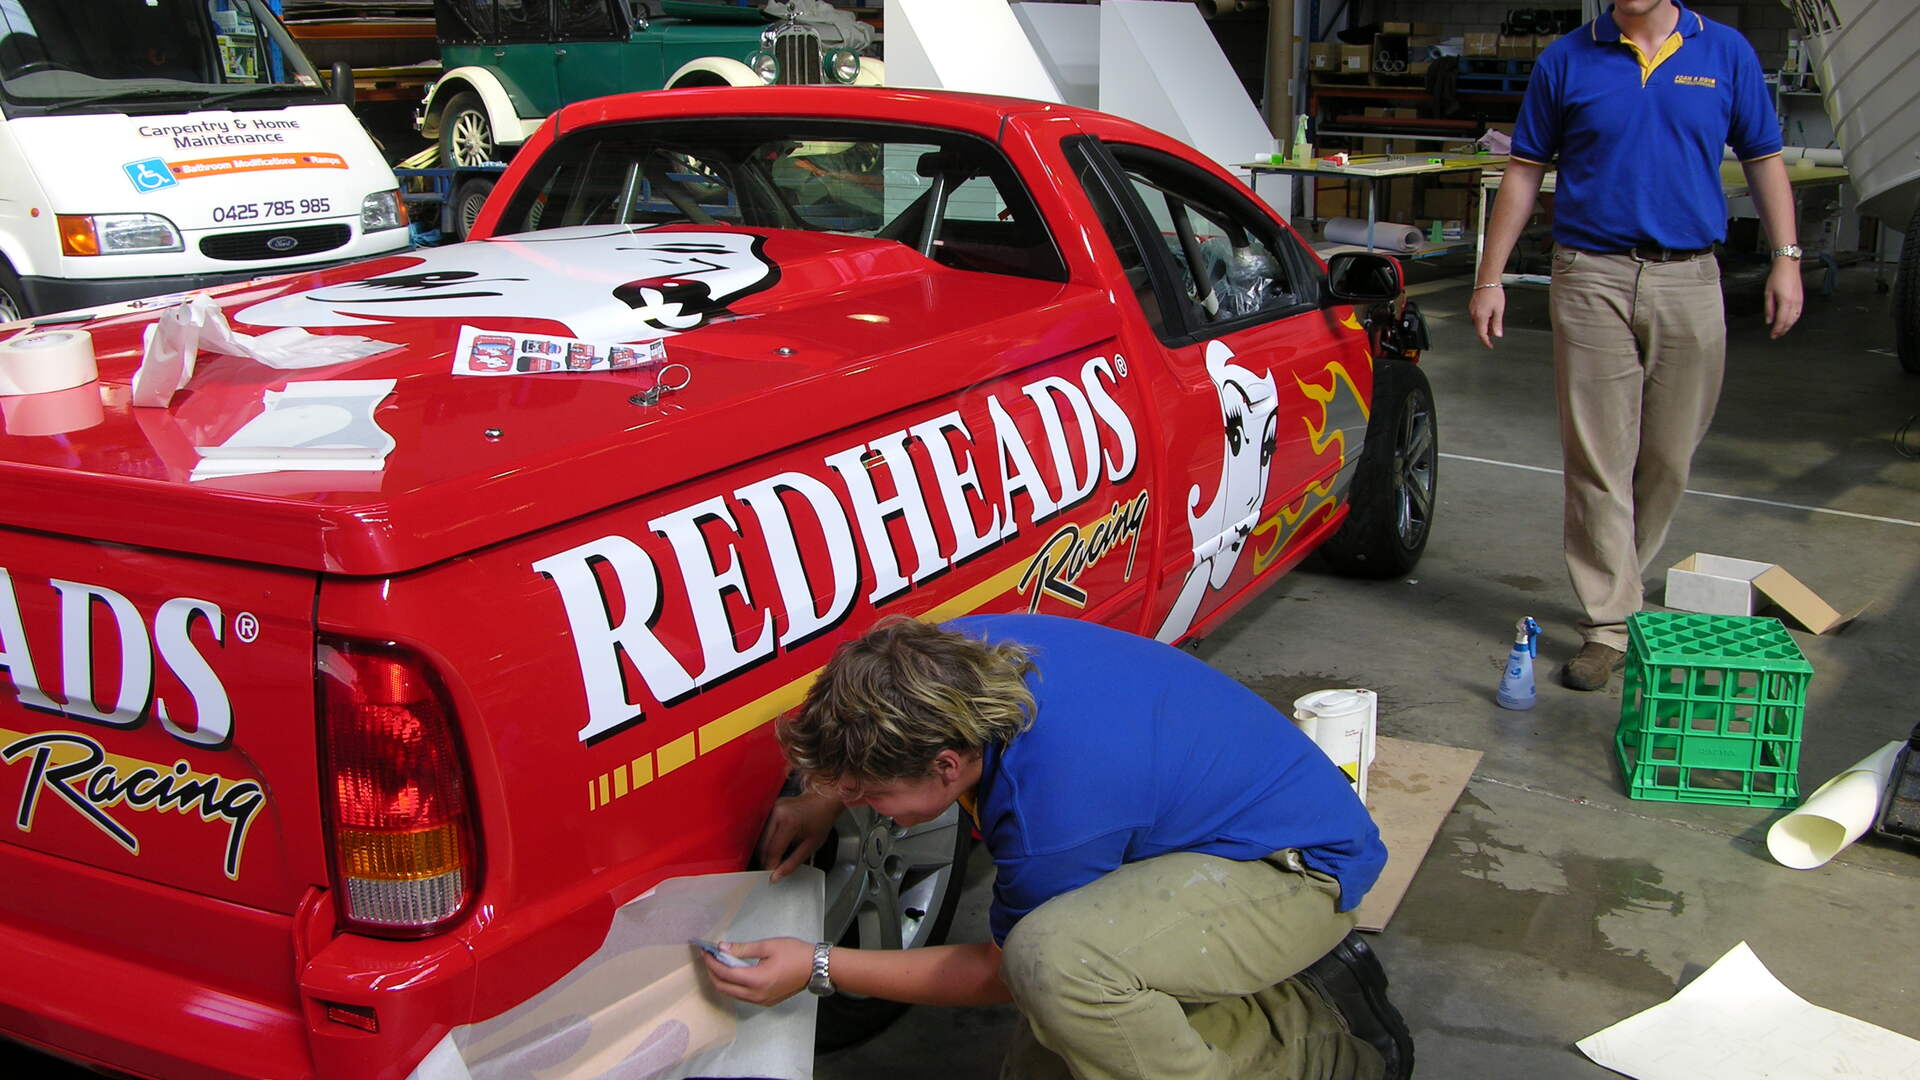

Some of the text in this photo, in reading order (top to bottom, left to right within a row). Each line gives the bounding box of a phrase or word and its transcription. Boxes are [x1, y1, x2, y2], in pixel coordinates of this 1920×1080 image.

[138, 119, 300, 137] Carpentry & Home
[173, 133, 284, 149] Maintenance
[182, 160, 232, 173] Bathroom
[234, 156, 296, 169] Modifications
[212, 197, 330, 223] 0425 785 985
[532, 356, 1138, 747] REDHEADS
[1017, 488, 1149, 614] Racing
[1, 731, 266, 880] Racing
